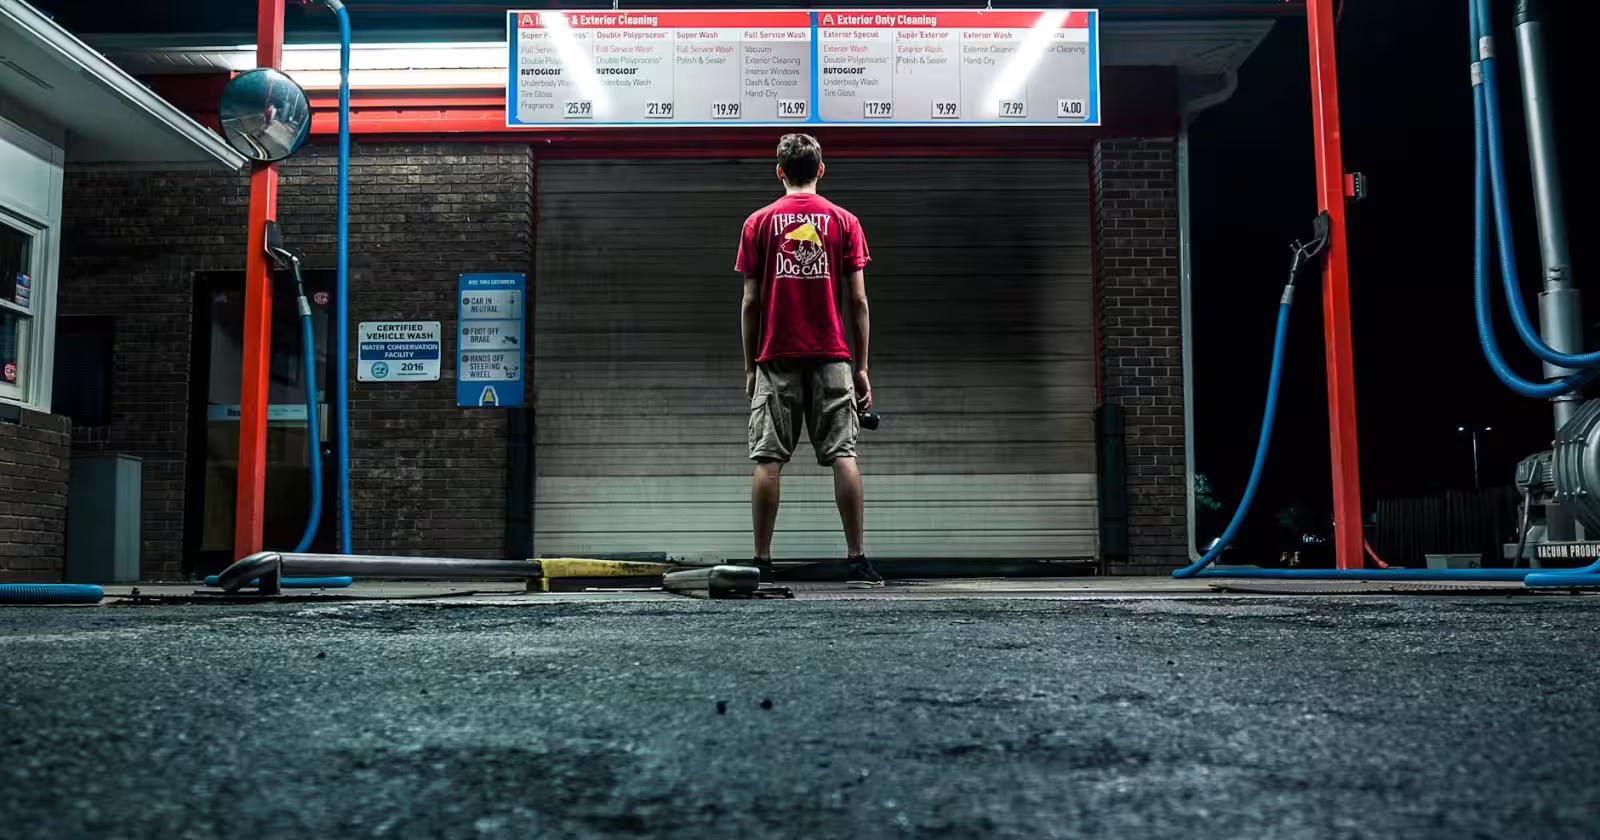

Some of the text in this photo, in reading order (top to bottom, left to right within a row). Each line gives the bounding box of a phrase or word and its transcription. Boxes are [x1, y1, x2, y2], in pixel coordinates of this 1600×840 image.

[580, 14, 616, 25] Exterior
[618, 14, 658, 27] Cleaning
[837, 14, 873, 25] Exterior
[875, 14, 895, 27] Only
[897, 14, 937, 27] Cleaning
[521, 31, 542, 40] Super
[597, 31, 621, 39] Double
[676, 31, 719, 40] Super Wash
[823, 30, 879, 39] Exterior Special
[897, 31, 949, 39] Super Exterior
[963, 31, 1012, 39] Exterior Wash
[610, 45, 633, 53] Service
[635, 45, 653, 53] Wash
[676, 45, 734, 53] Full Service Wash
[745, 45, 772, 53] Vacuum
[823, 44, 869, 53] Exterior Wash
[897, 45, 942, 53] Exterior Wash
[963, 45, 1016, 54] Exterior Cleanin
[1056, 45, 1086, 55] Cleaning
[596, 56, 619, 65] Double
[676, 56, 727, 64] Polish & Sealer
[745, 56, 801, 66] Exterior Cleaning
[823, 55, 847, 64] Double
[897, 56, 948, 64] Polish & Sealer
[963, 56, 995, 66] Hand-Dry
[745, 67, 800, 75] Interior Windows
[521, 79, 556, 88] Underbody
[745, 78, 798, 86] Dash & Console
[823, 78, 879, 87] Underbody Wash
[521, 90, 552, 98] Tire Gloss
[745, 89, 778, 99] Hand-Dry
[823, 89, 856, 97] Tire Gloss
[521, 101, 554, 111] Fragrance
[565, 102, 591, 114] $25.99
[646, 102, 672, 114] $21.99
[713, 103, 739, 115] $19.99
[779, 102, 805, 114] $16.99
[865, 102, 891, 115] $17.99
[936, 103, 957, 115] $9.99
[1003, 102, 1024, 114] $7.99
[1061, 102, 1082, 114] $4.00
[772, 213, 831, 236] THE SALTY
[776, 252, 800, 275] DOG
[471, 297, 492, 305] CAR IN
[470, 305, 498, 313] NEUTRAL
[376, 324, 424, 332] CERTIFIED
[470, 327, 499, 336] FOOT OFF
[366, 332, 434, 340] VEHICLE WASH
[470, 335, 491, 343] BRAKE
[386, 343, 438, 351] CONSERVATION
[469, 354, 504, 363] HANDS OFF
[401, 362, 424, 371] 2016
[469, 362, 500, 371] STEERING
[469, 370, 491, 378] WHEEL
[1537, 545, 1568, 558] VACUUM
